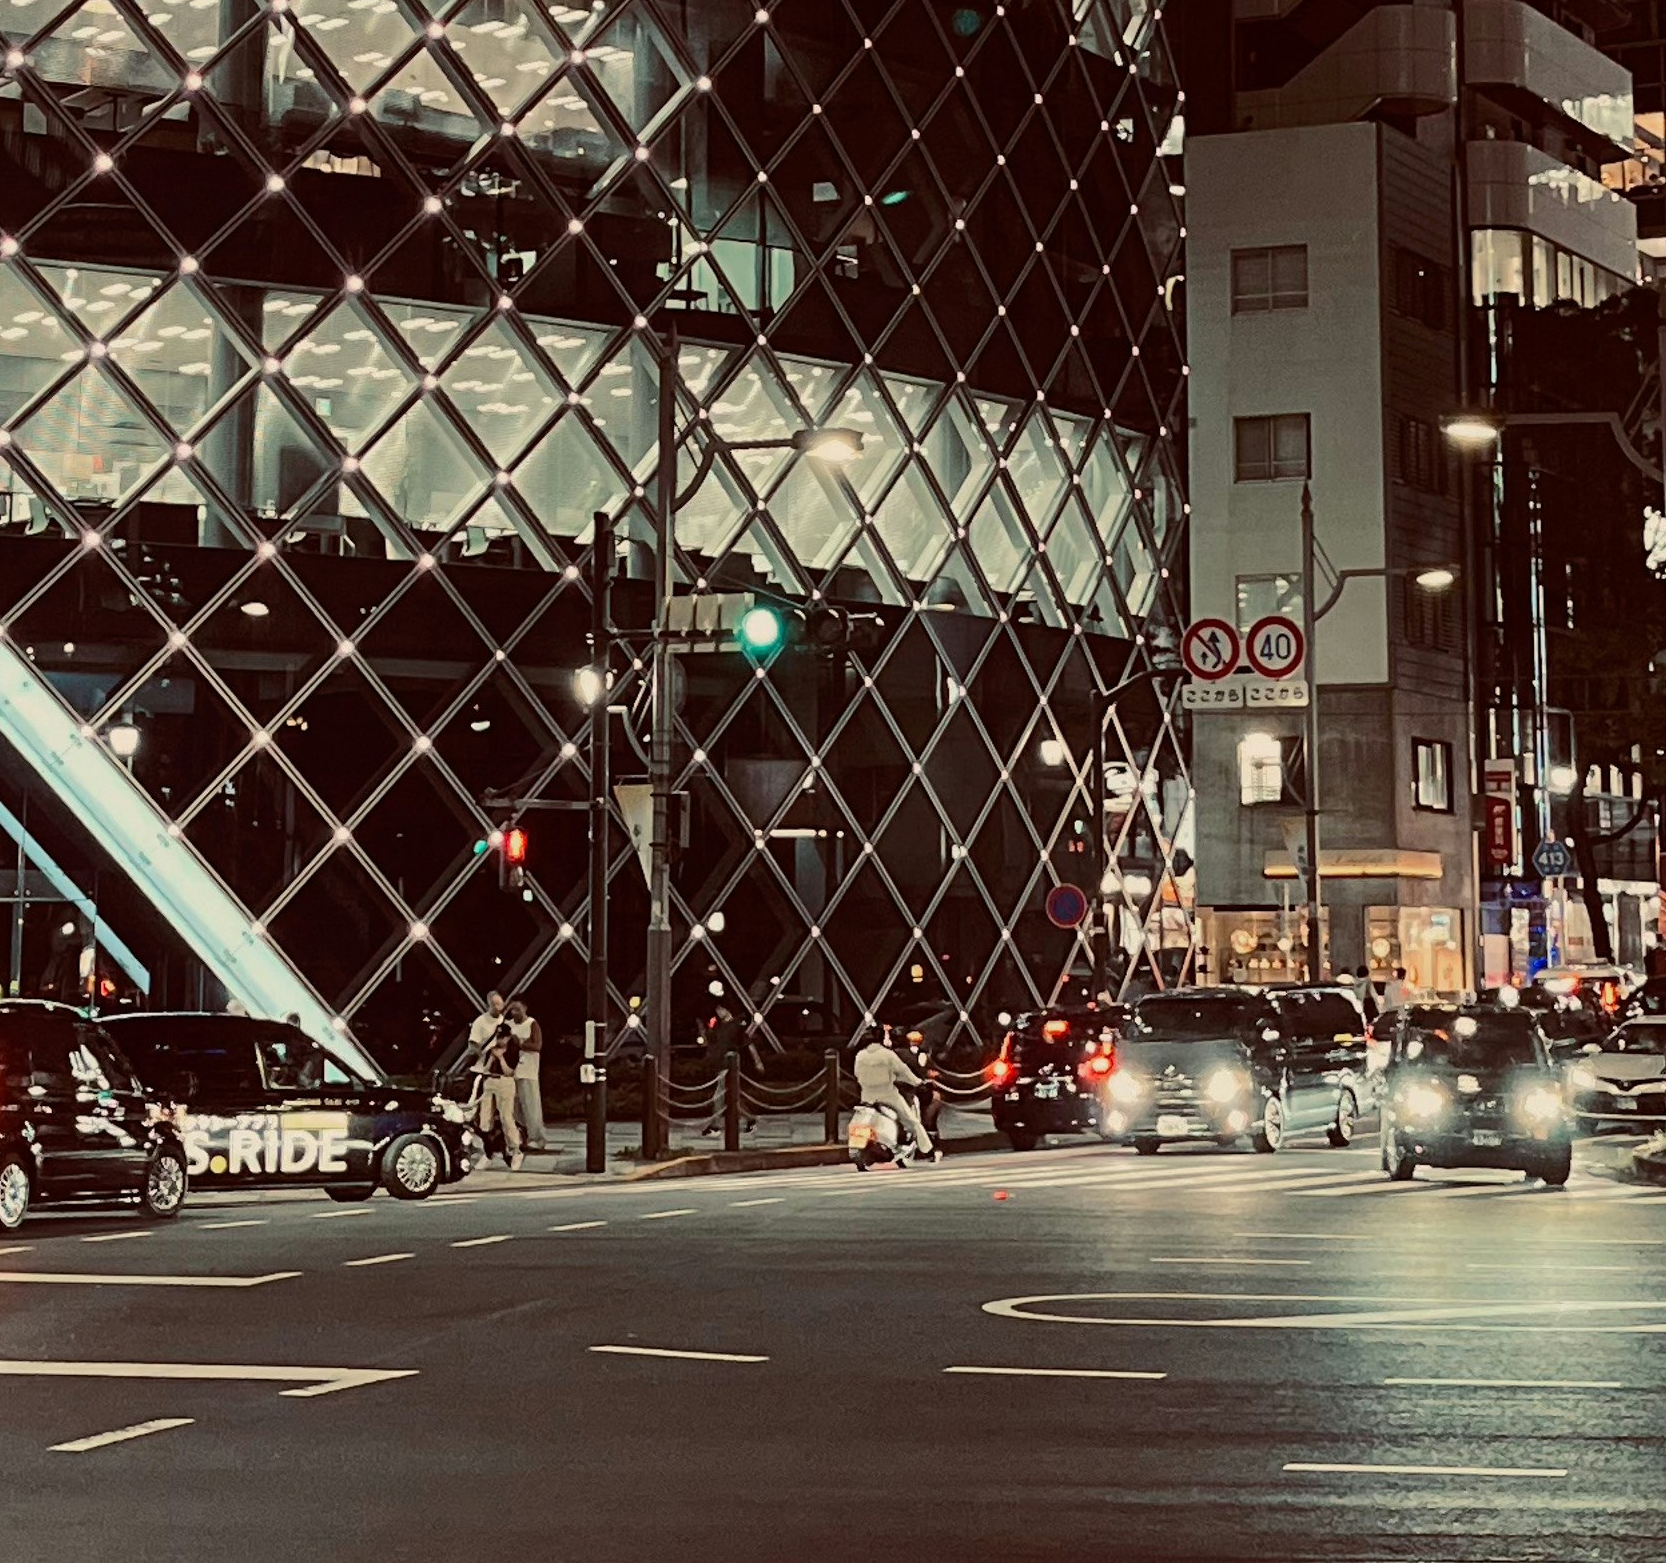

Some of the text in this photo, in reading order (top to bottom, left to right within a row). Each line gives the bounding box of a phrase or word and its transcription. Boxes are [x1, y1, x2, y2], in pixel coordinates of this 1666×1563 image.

[1260, 633, 1291, 660] 40
[1186, 689, 1240, 703] ここから
[1250, 686, 1304, 701] ここから
[1538, 851, 1565, 866] 413
[183, 1129, 349, 1175] S.RIDE
